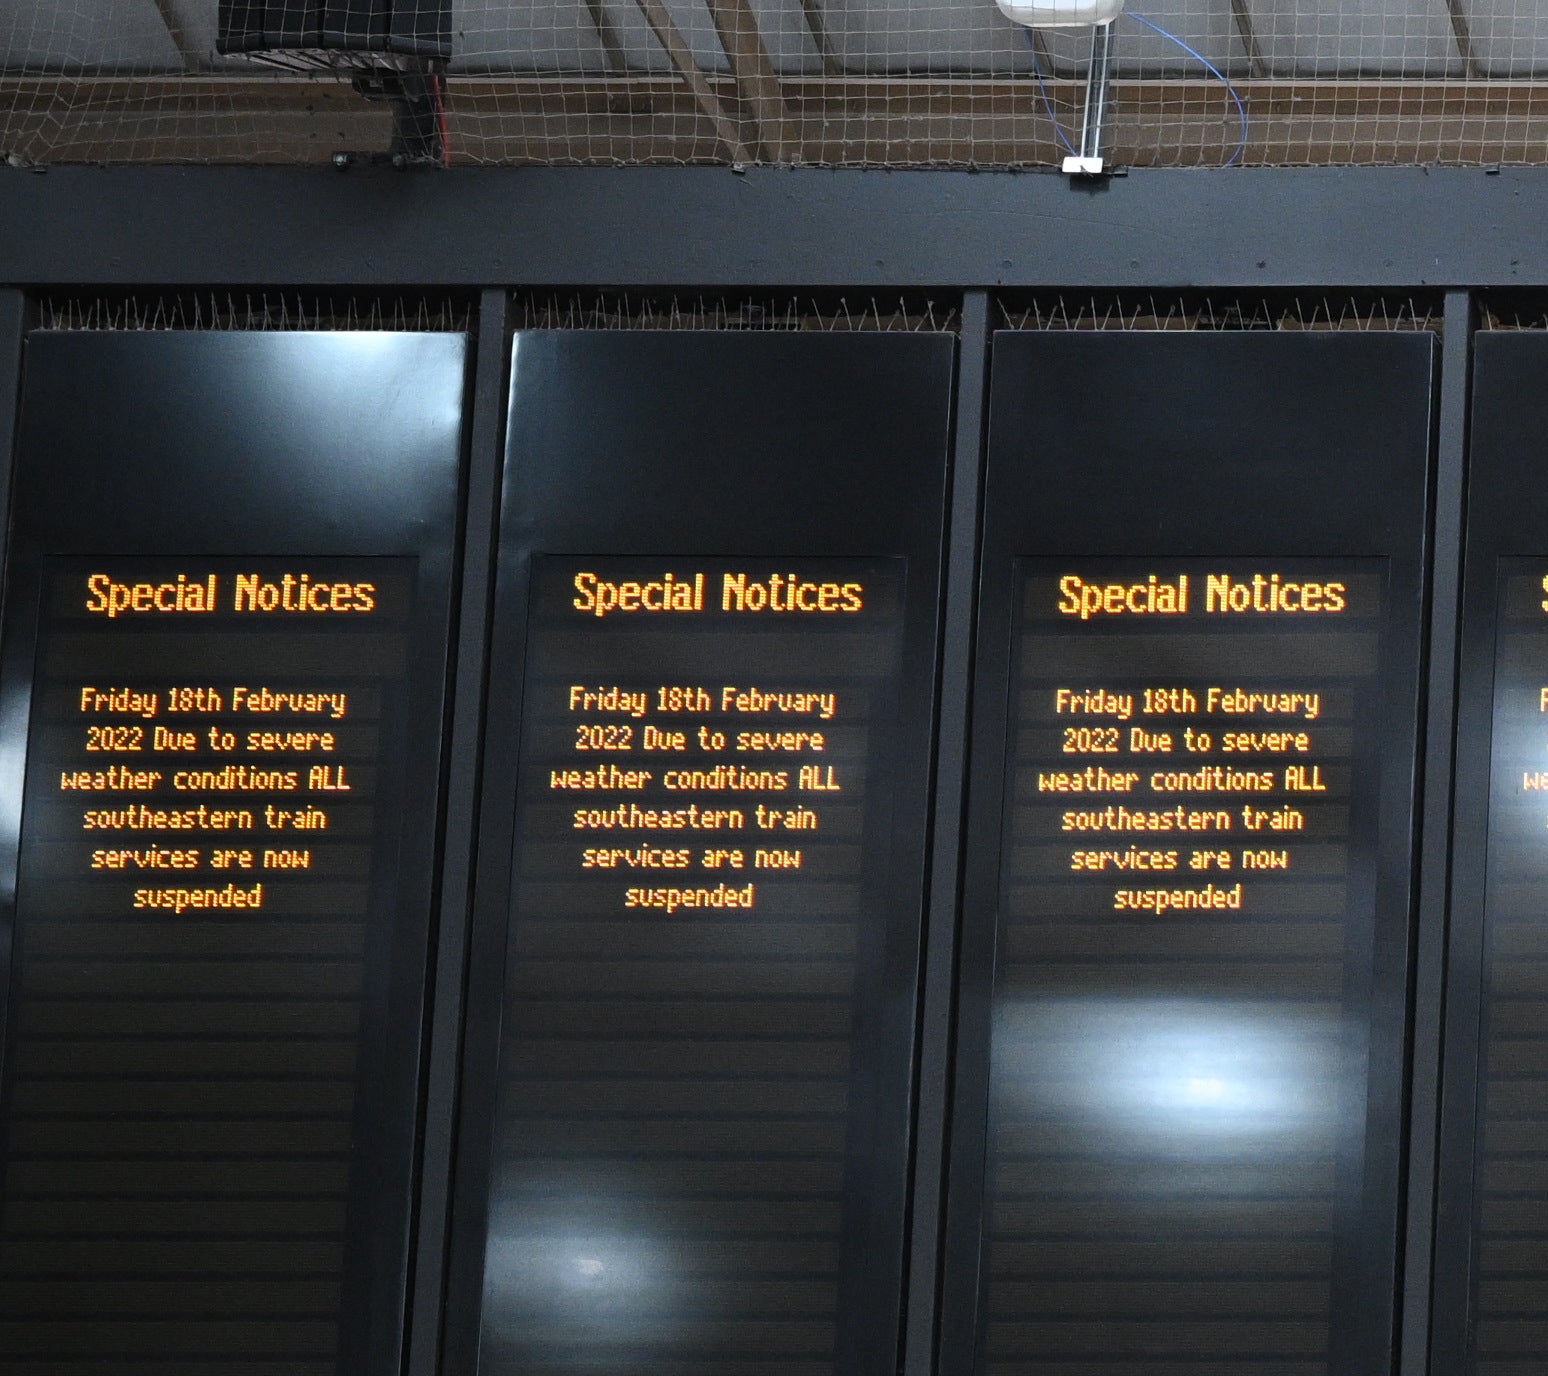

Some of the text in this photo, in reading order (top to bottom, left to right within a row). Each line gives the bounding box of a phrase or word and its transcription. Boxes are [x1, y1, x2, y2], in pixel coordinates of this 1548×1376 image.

[86, 573, 376, 618] Special Notices
[573, 572, 864, 617] Special Notices
[1058, 573, 1347, 621] Special Notices
